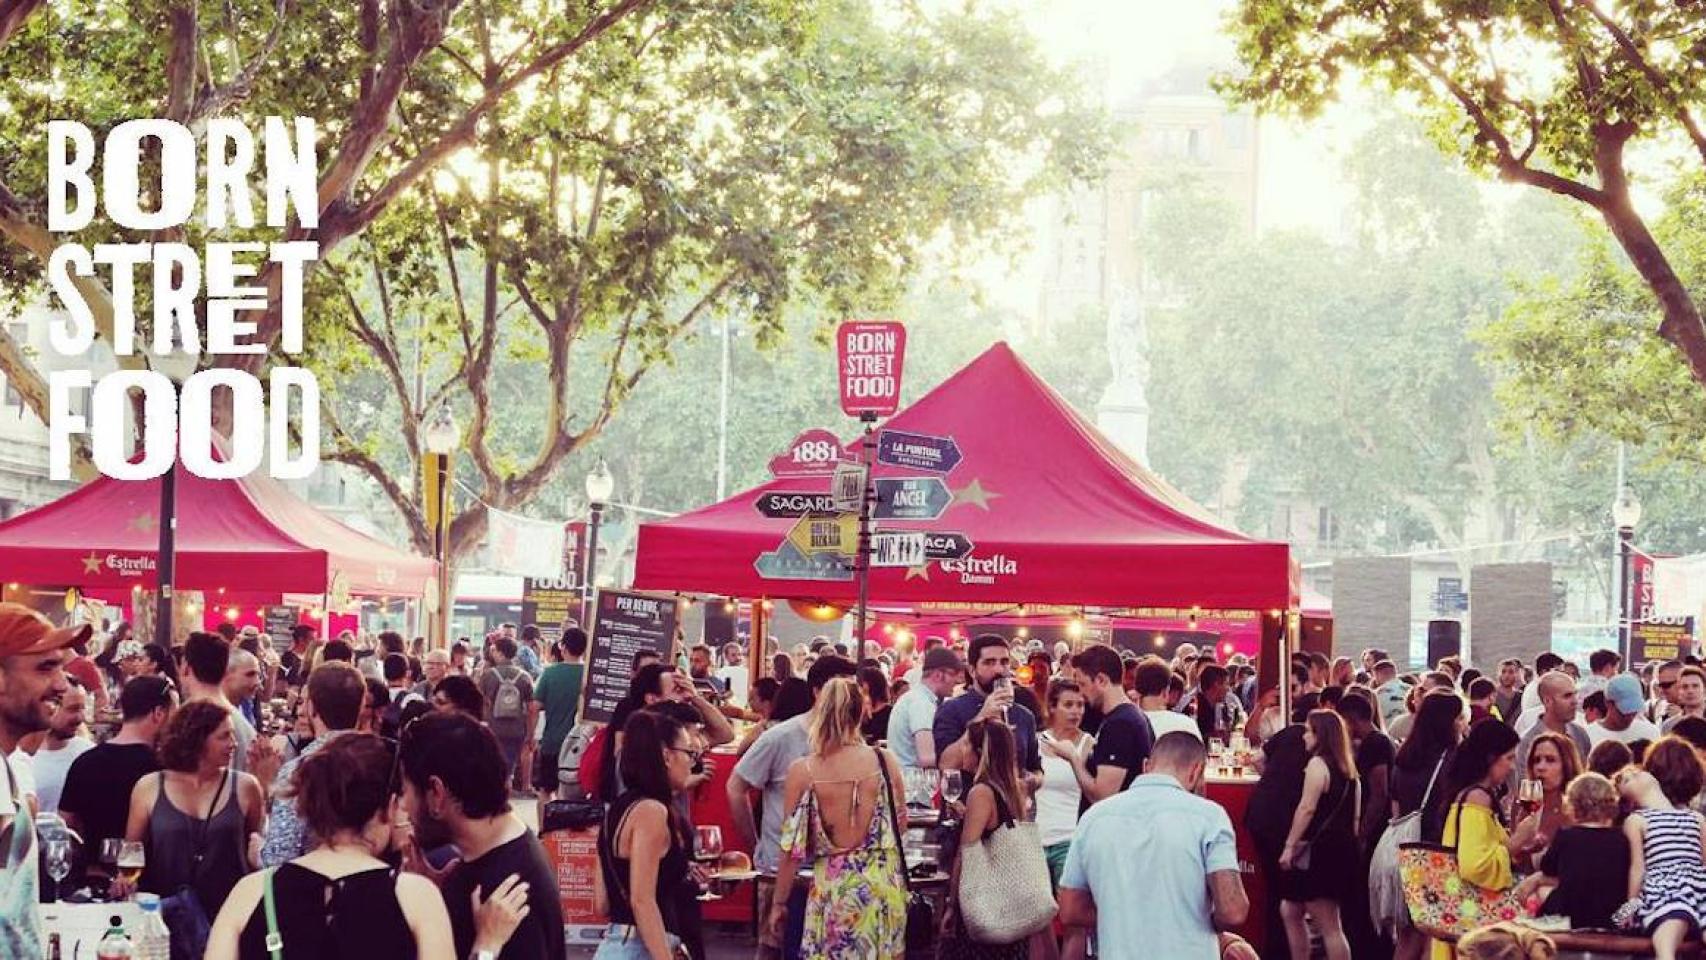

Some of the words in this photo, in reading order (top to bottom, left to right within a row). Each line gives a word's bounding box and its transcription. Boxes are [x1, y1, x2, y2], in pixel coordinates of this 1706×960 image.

[847, 332, 895, 353] BORN
[847, 376, 895, 398] FOOD
[792, 441, 838, 463] 1881
[770, 495, 834, 511] SAGARD
[877, 537, 896, 563] WC
[924, 538, 957, 550] ACA
[104, 554, 156, 569] Estrella
